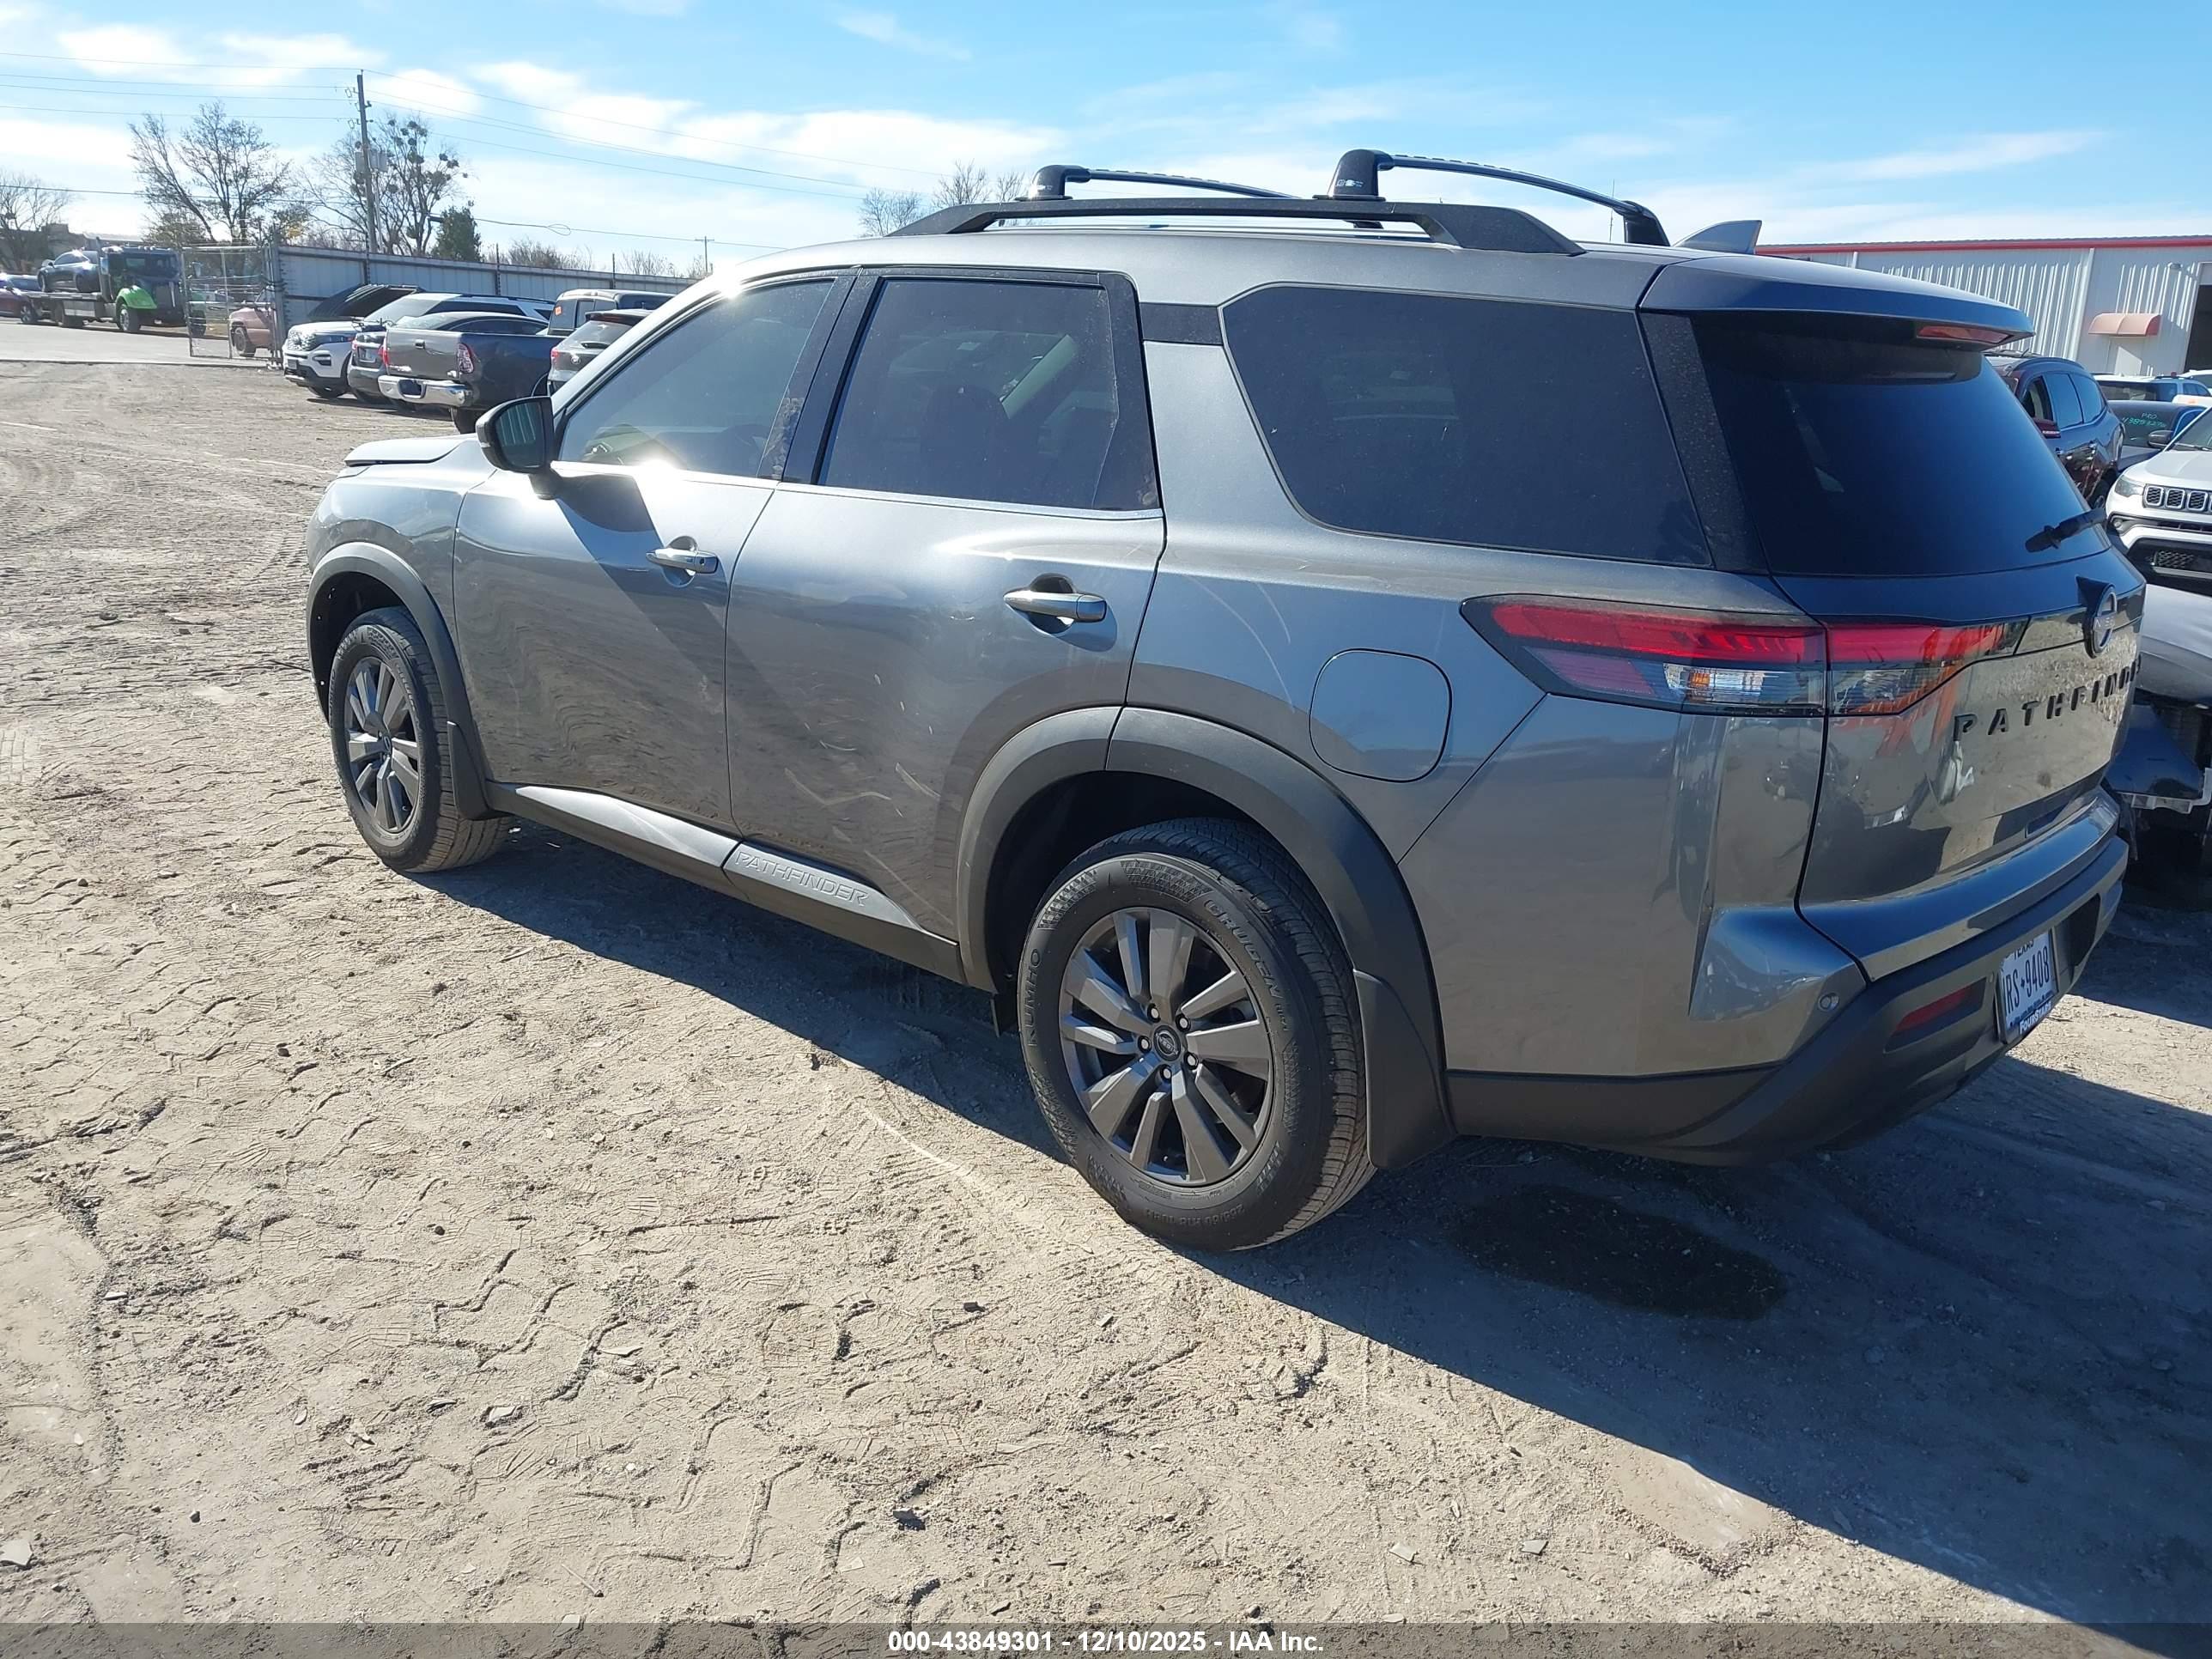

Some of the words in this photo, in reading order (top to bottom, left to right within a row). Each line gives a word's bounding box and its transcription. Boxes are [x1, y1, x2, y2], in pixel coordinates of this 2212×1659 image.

[735, 851, 869, 906] PATHFINDER
[1204, 899, 1283, 998] CRUGEN
[1024, 949, 1042, 1046] KUMHO
